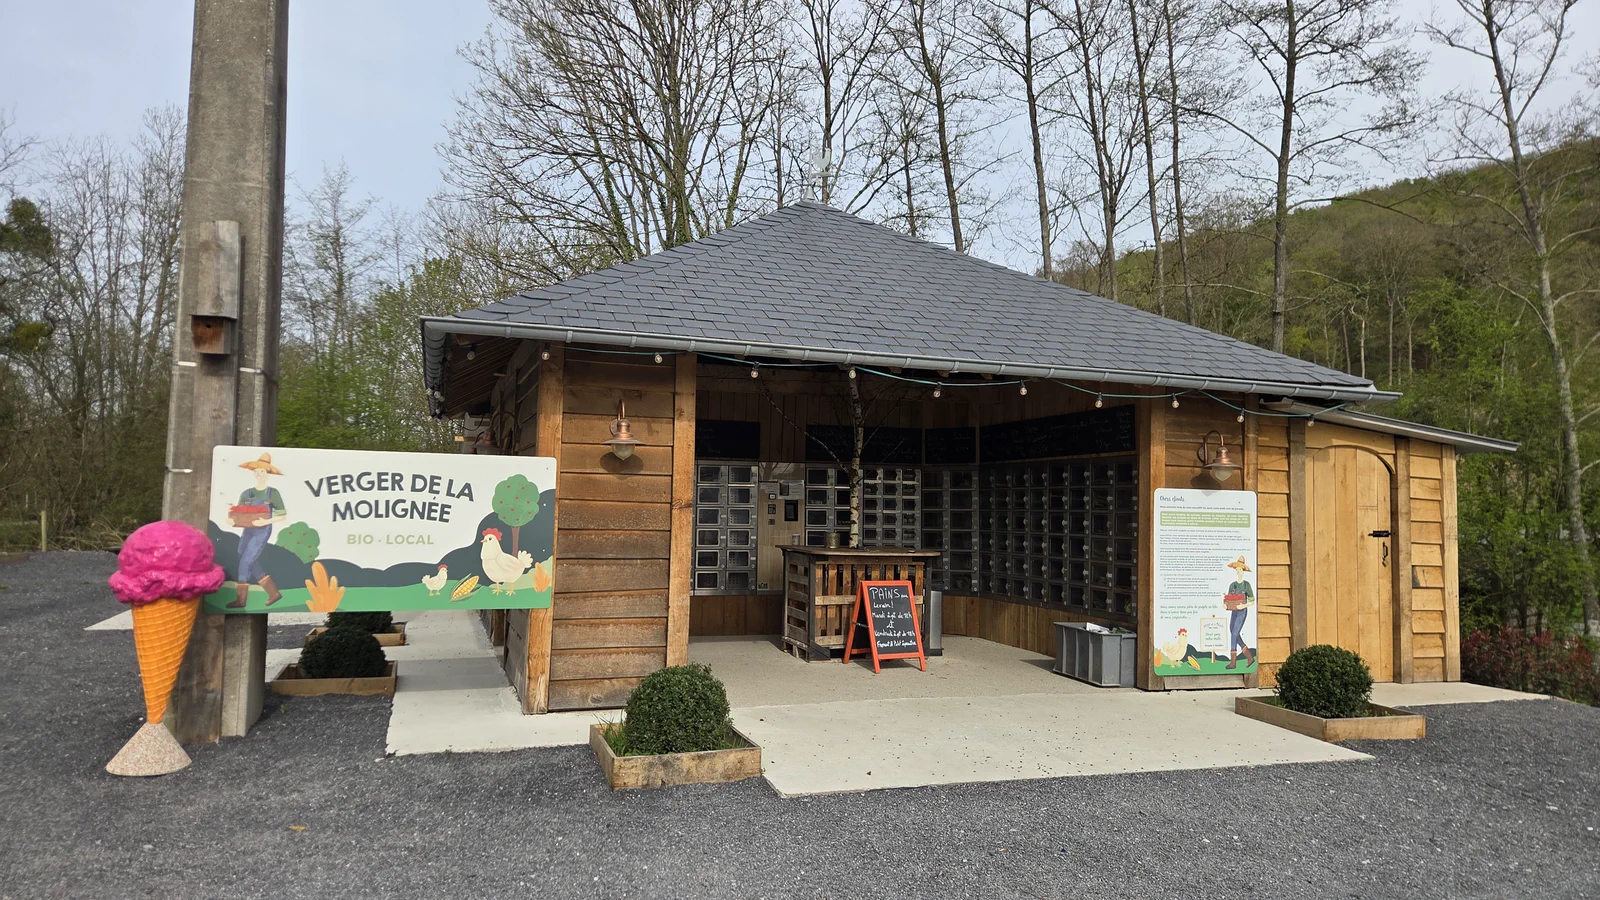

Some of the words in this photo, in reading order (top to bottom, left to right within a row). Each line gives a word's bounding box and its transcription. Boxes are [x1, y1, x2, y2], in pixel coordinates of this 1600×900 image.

[304, 471, 404, 498] VERGER
[410, 473, 442, 495] DE
[445, 478, 474, 502] LA
[332, 496, 452, 523] MOLIGNÉE
[346, 534, 374, 545] BIO
[385, 534, 434, 545] LOCAL
